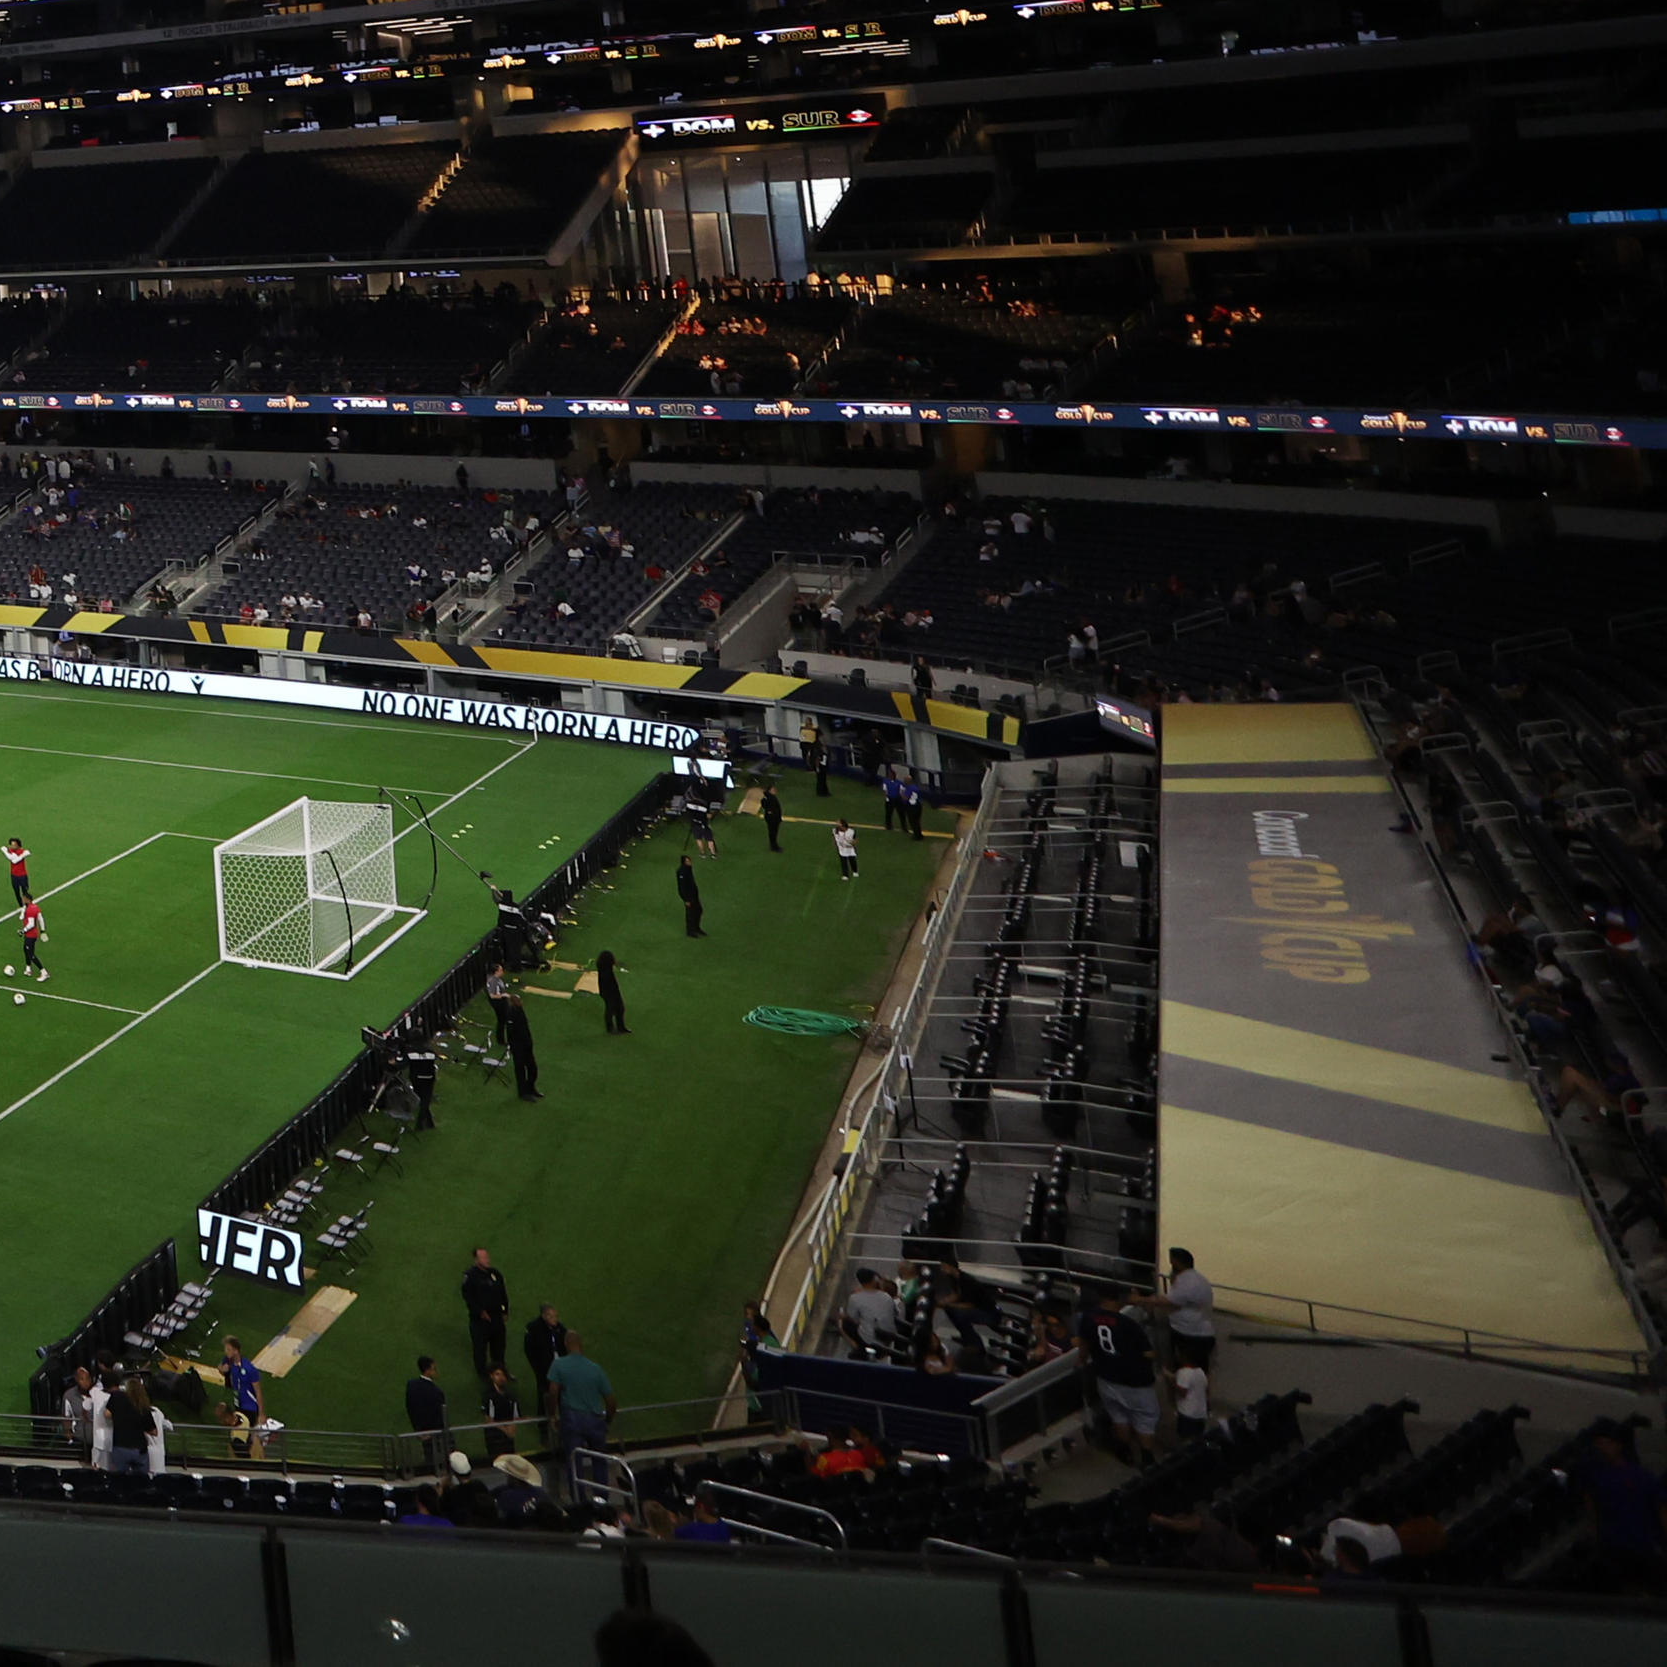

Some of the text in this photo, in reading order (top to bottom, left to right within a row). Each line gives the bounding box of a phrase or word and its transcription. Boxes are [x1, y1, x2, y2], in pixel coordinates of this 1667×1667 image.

[672, 117, 736, 137] DOM
[782, 110, 840, 128] SUR
[92, 668, 105, 686] A
[362, 690, 397, 715] NO
[403, 695, 454, 722] ONE
[461, 700, 517, 728] WAS
[523, 707, 596, 737] BORN
[603, 718, 619, 740] A
[1259, 933, 1371, 984] CUP
[1098, 1325, 1115, 1354] 8
